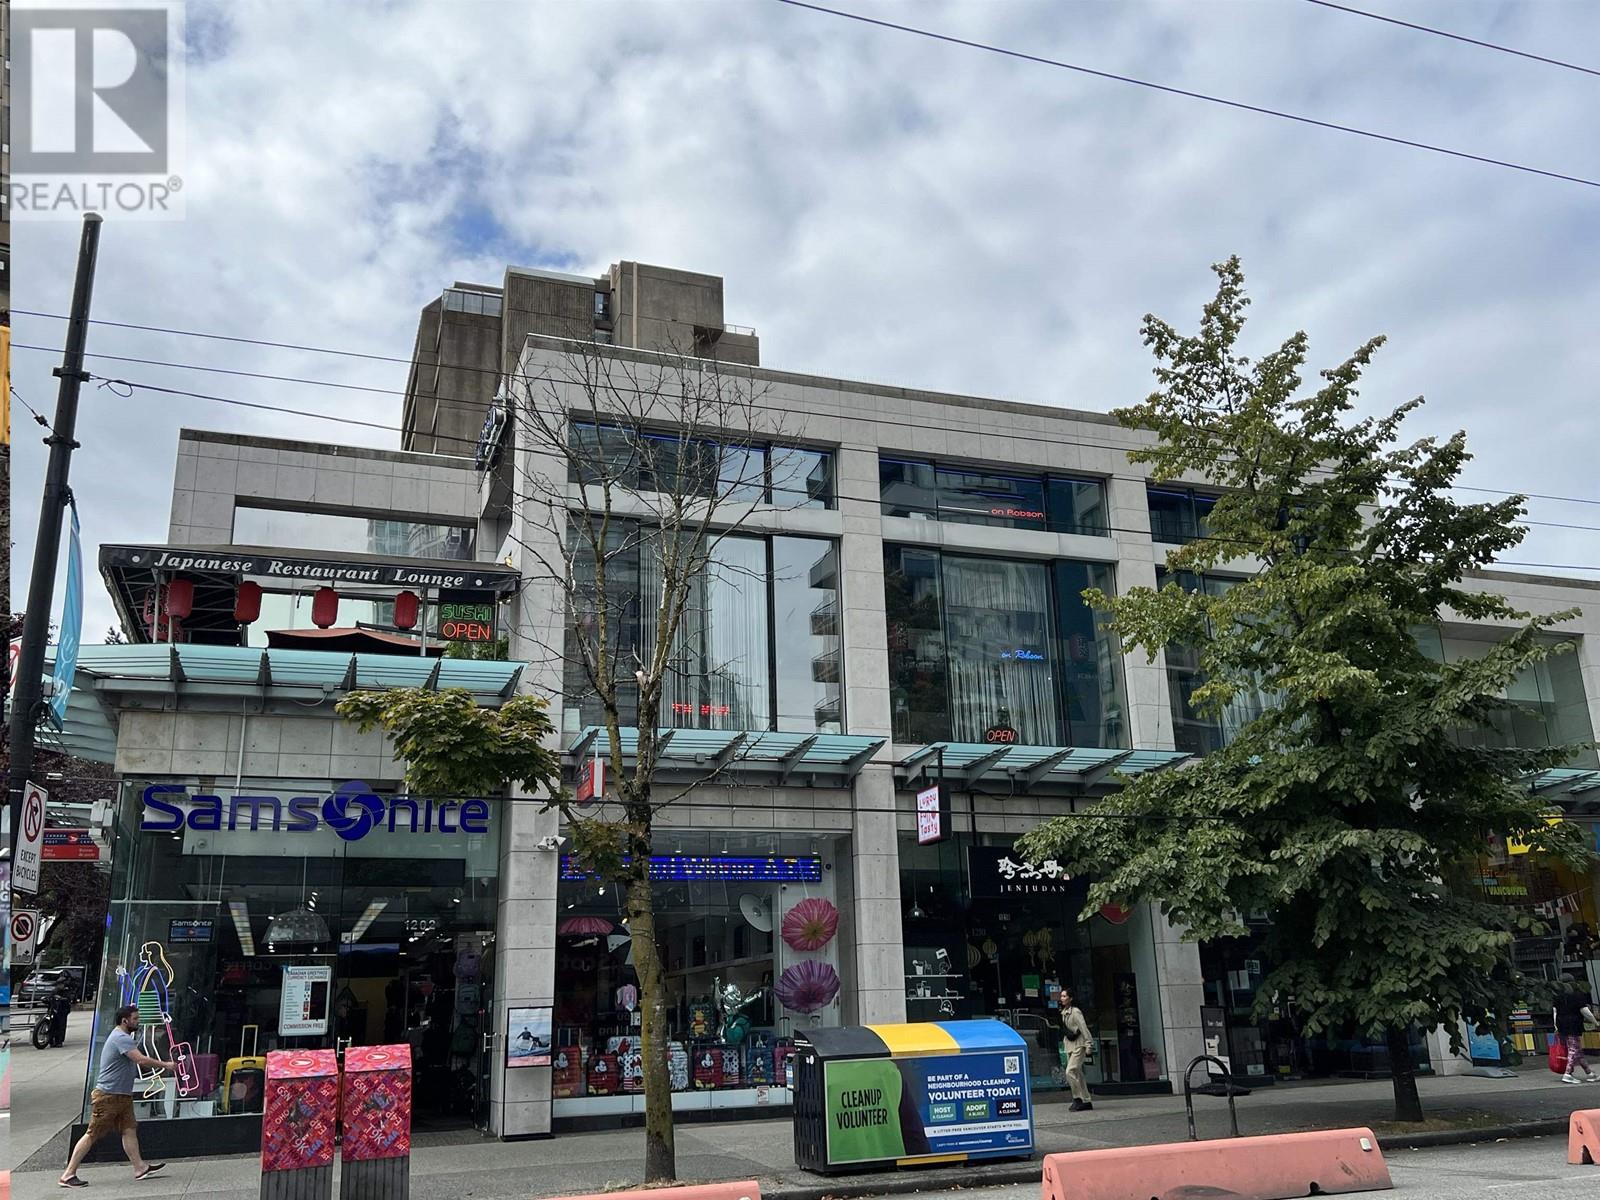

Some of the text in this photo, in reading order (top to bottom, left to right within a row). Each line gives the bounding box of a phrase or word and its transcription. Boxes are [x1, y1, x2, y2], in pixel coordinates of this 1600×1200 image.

[1006, 508, 1044, 518] Robson
[154, 552, 464, 588] Japanese Restaurant Lounge
[441, 604, 492, 620] SUSHI
[443, 622, 490, 640] OPEN
[986, 730, 1015, 742] OPEN
[20, 849, 36, 863] EXCEPT
[16, 864, 37, 881] BICYCLES
[1000, 884, 1066, 893] JENJUDAN
[1488, 886, 1528, 896] VANCOUVER
[403, 919, 436, 930] 1202
[927, 1081, 982, 1090] NEIGHBOURHOOD
[841, 1088, 882, 1109] CLEANUP
[928, 1086, 1021, 1102] VOLUNTEER TODAY!
[934, 1106, 951, 1114] HOST
[965, 1103, 987, 1111] ADOPT
[836, 1108, 888, 1130] VOLUNTEER
